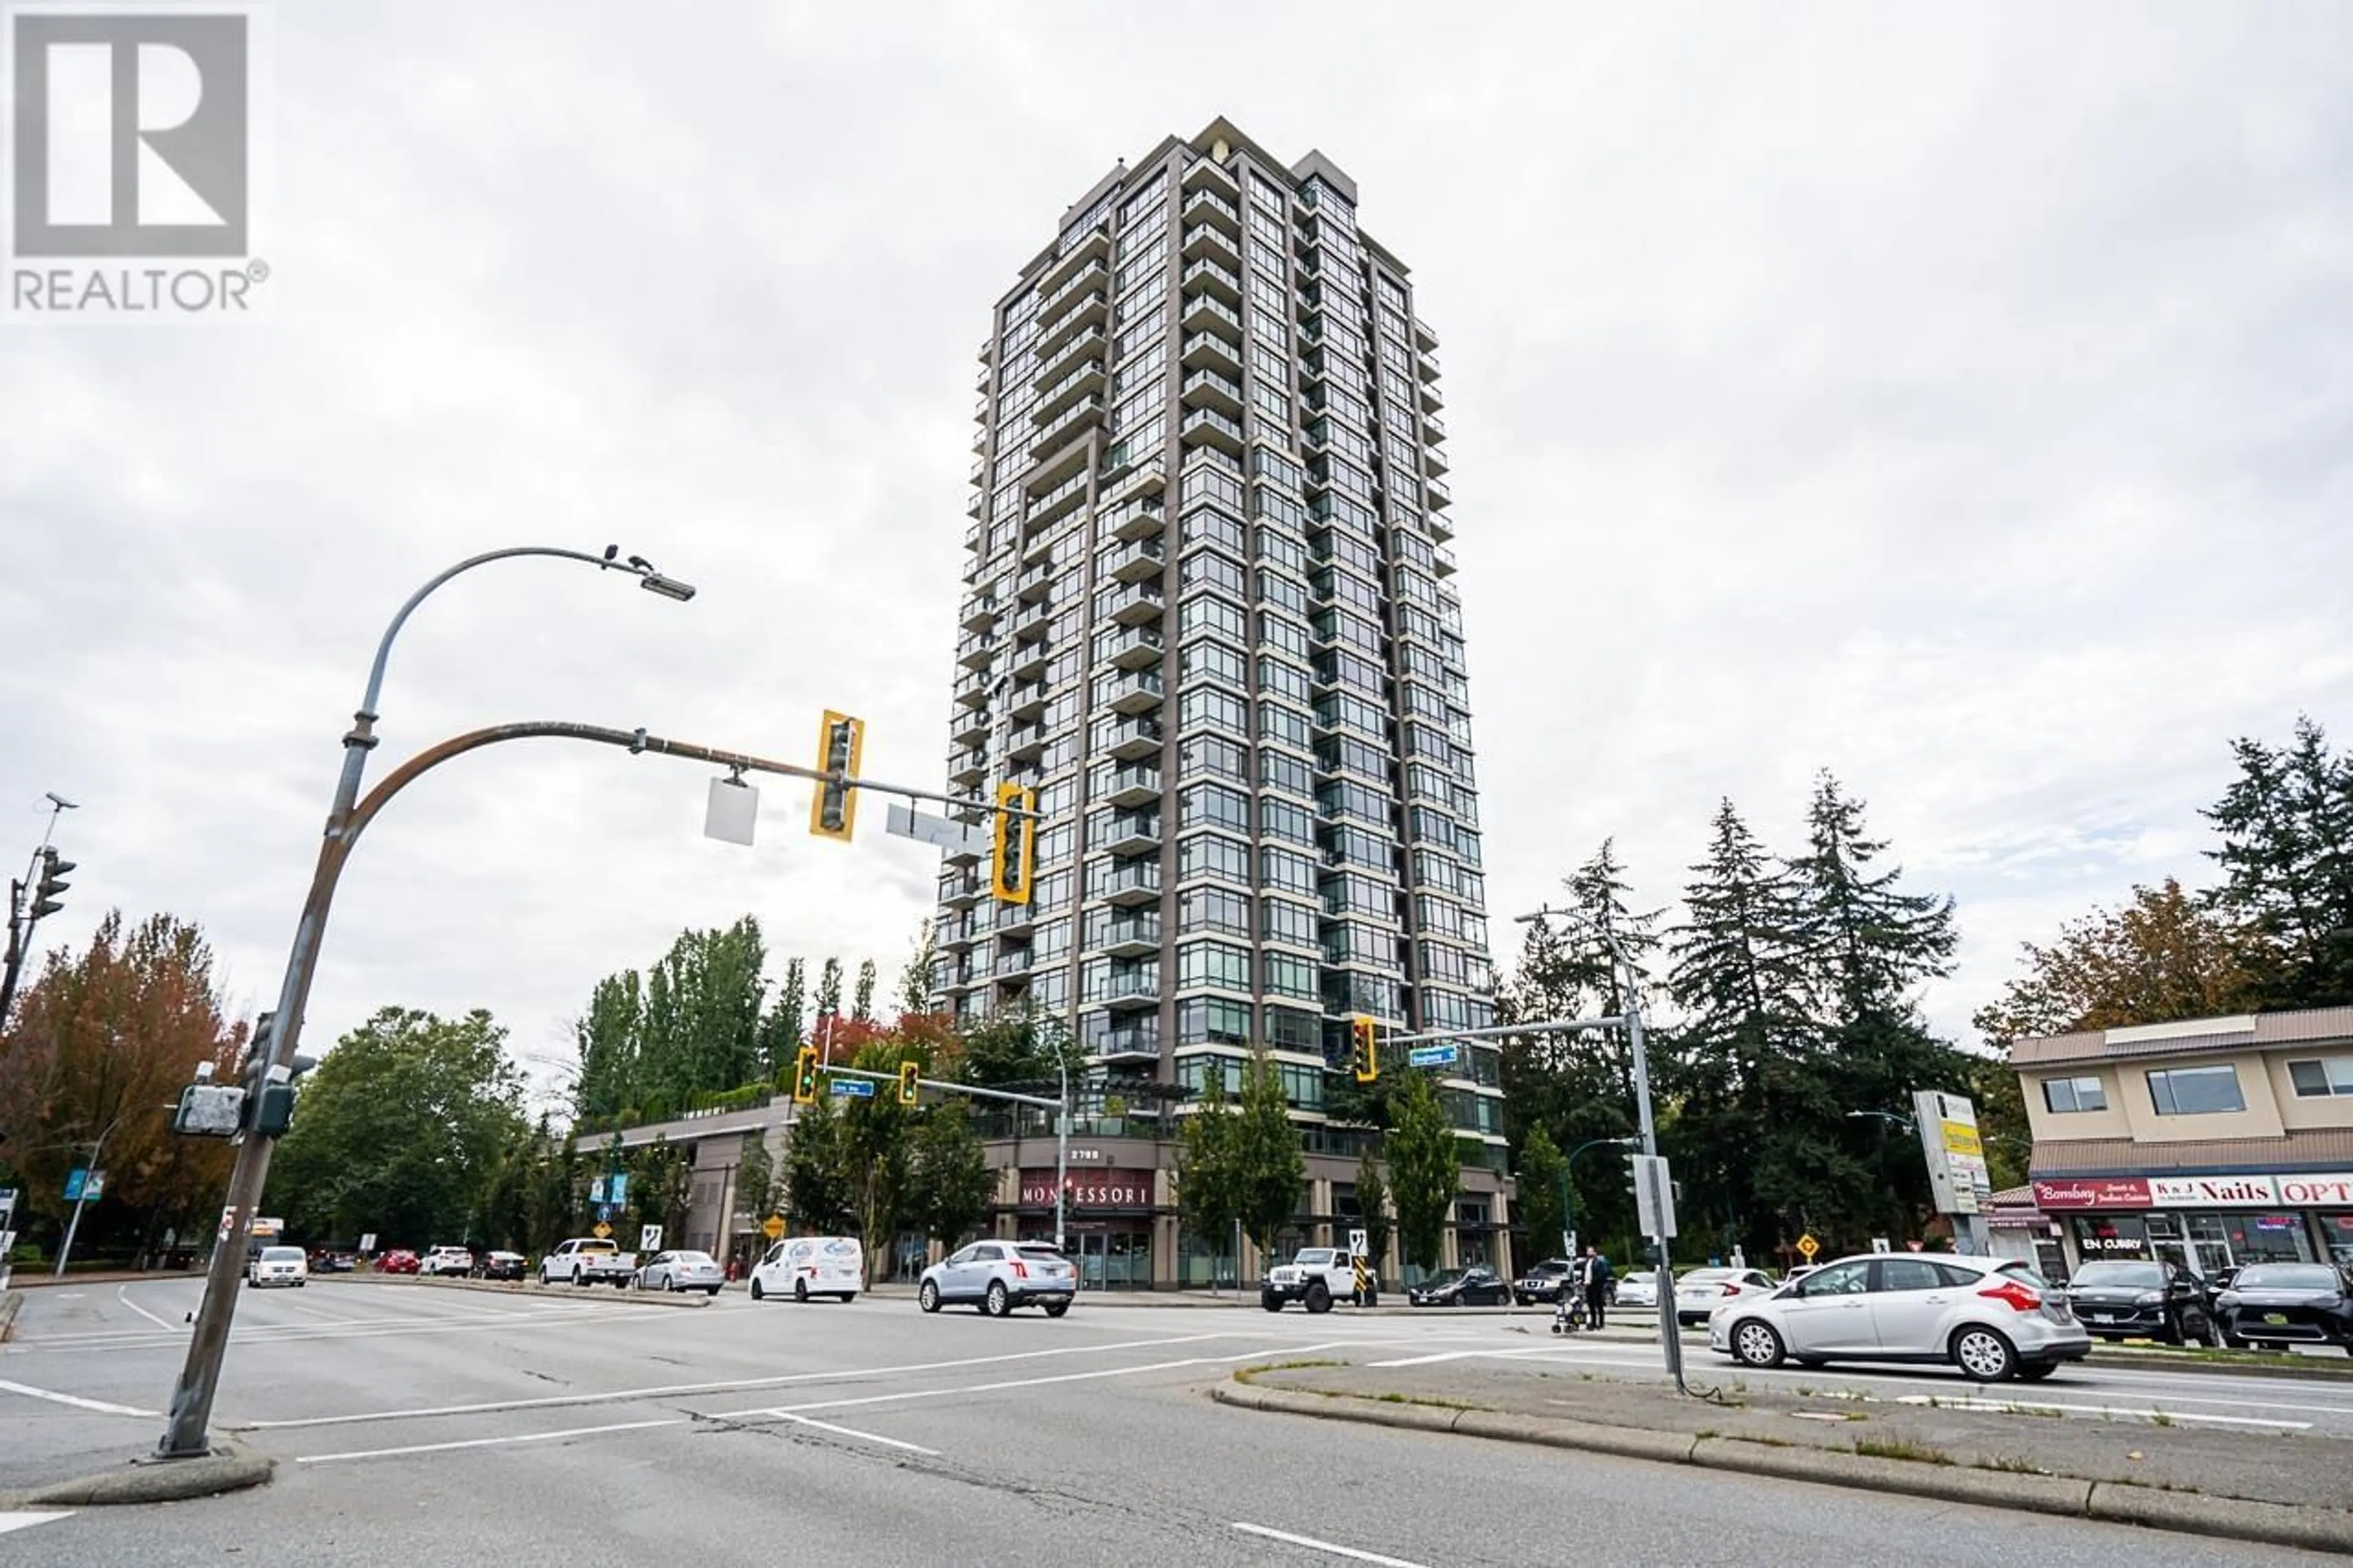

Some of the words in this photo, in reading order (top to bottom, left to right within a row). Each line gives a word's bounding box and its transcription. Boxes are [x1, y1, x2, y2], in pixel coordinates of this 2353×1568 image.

[1022, 1187, 1146, 1204] MONESSORI
[2041, 1183, 2095, 1207] Bombay
[2156, 1183, 2169, 1194] K
[2199, 1181, 2269, 1200] Nails
[2284, 1182, 2353, 1202] OPT
